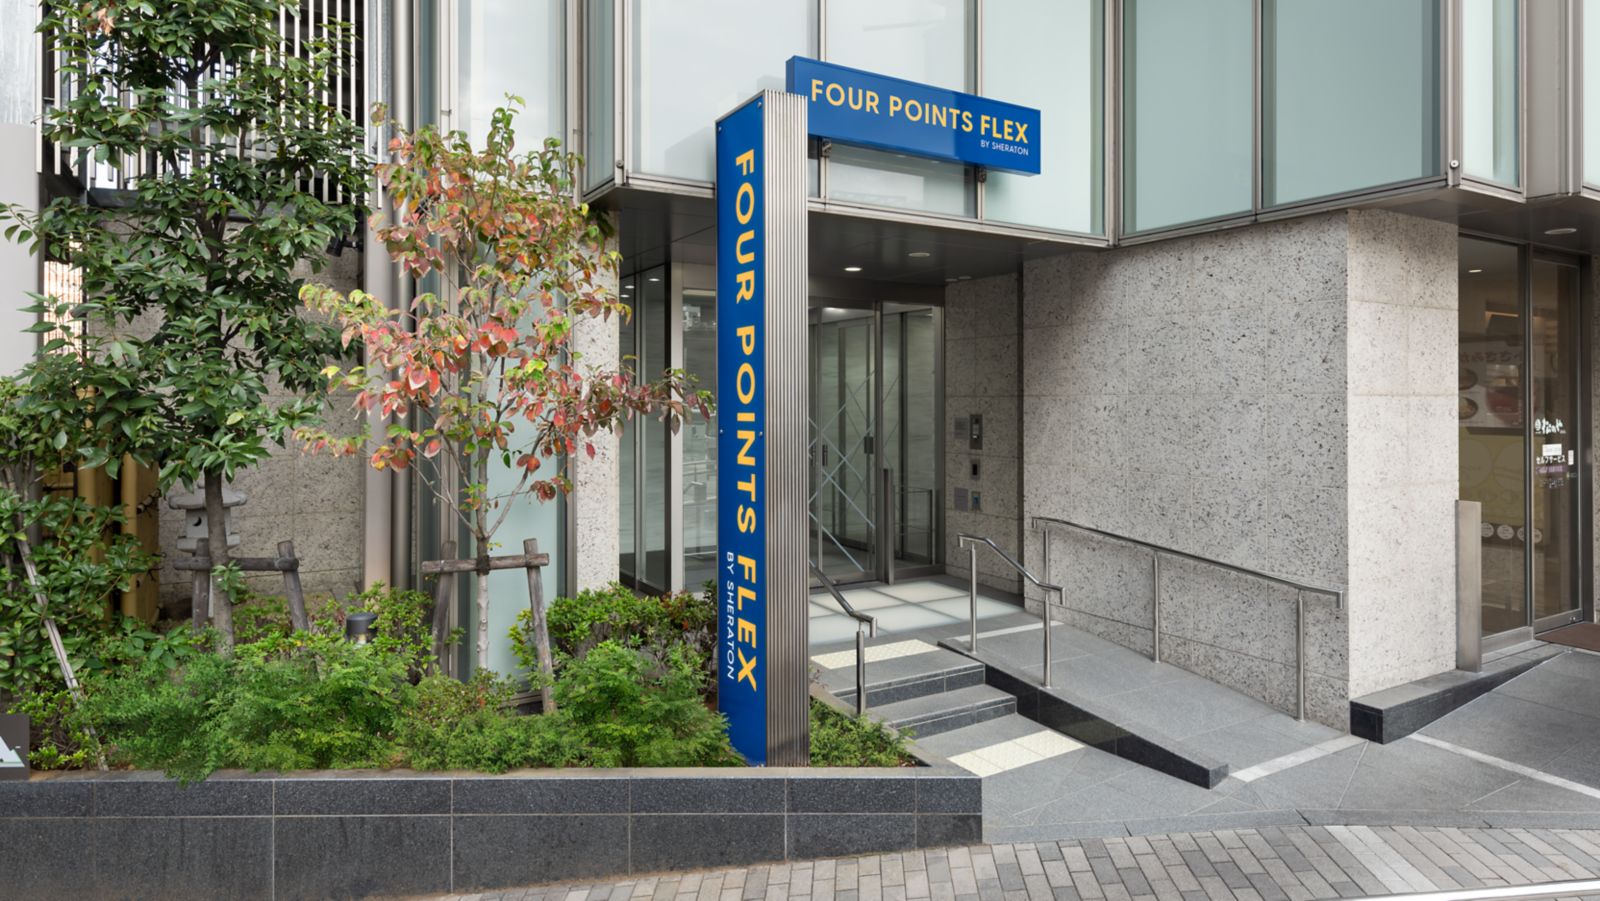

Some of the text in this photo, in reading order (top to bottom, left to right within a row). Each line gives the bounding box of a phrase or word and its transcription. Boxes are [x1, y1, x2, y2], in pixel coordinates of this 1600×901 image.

[811, 79, 1029, 144] FOUR POINTS FLEX
[980, 139, 1029, 156] BY SHERATON
[735, 148, 757, 692] FOUR POINTS FLEX
[726, 551, 735, 680] BY SHERATON
